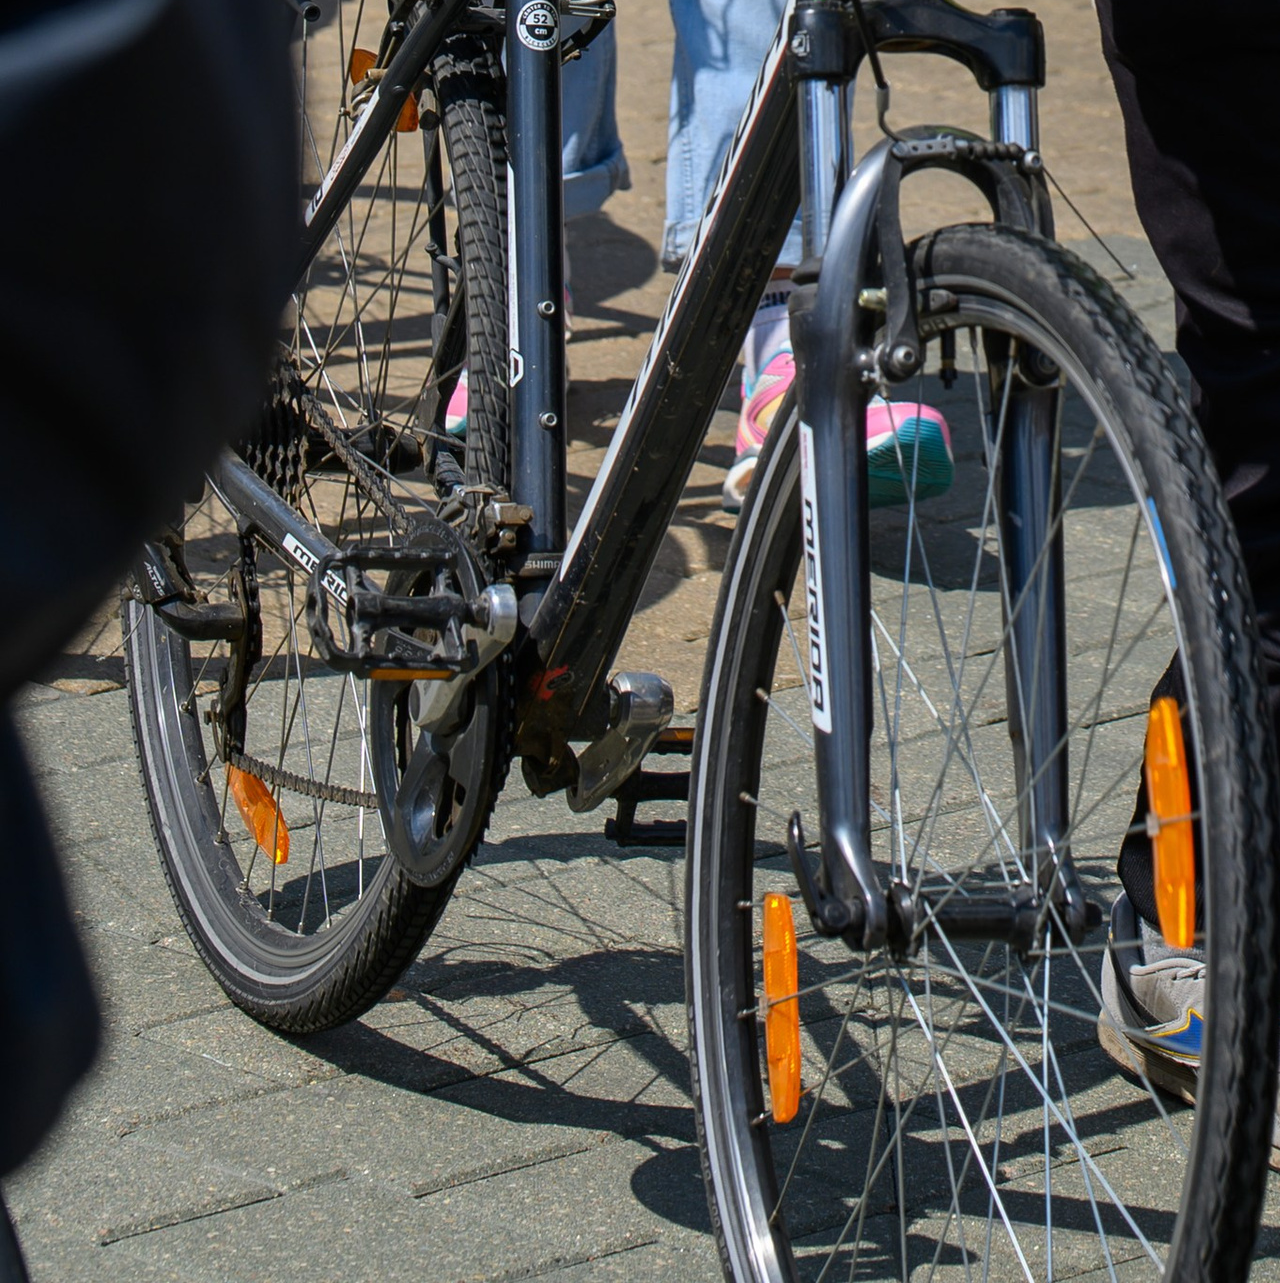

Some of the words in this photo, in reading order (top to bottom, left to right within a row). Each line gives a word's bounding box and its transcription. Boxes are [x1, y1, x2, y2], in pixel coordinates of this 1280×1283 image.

[533, 13, 548, 24] 52
[534, 27, 548, 35] cm
[143, 561, 166, 596] ALTUS
[804, 498, 825, 713] MERIDA
